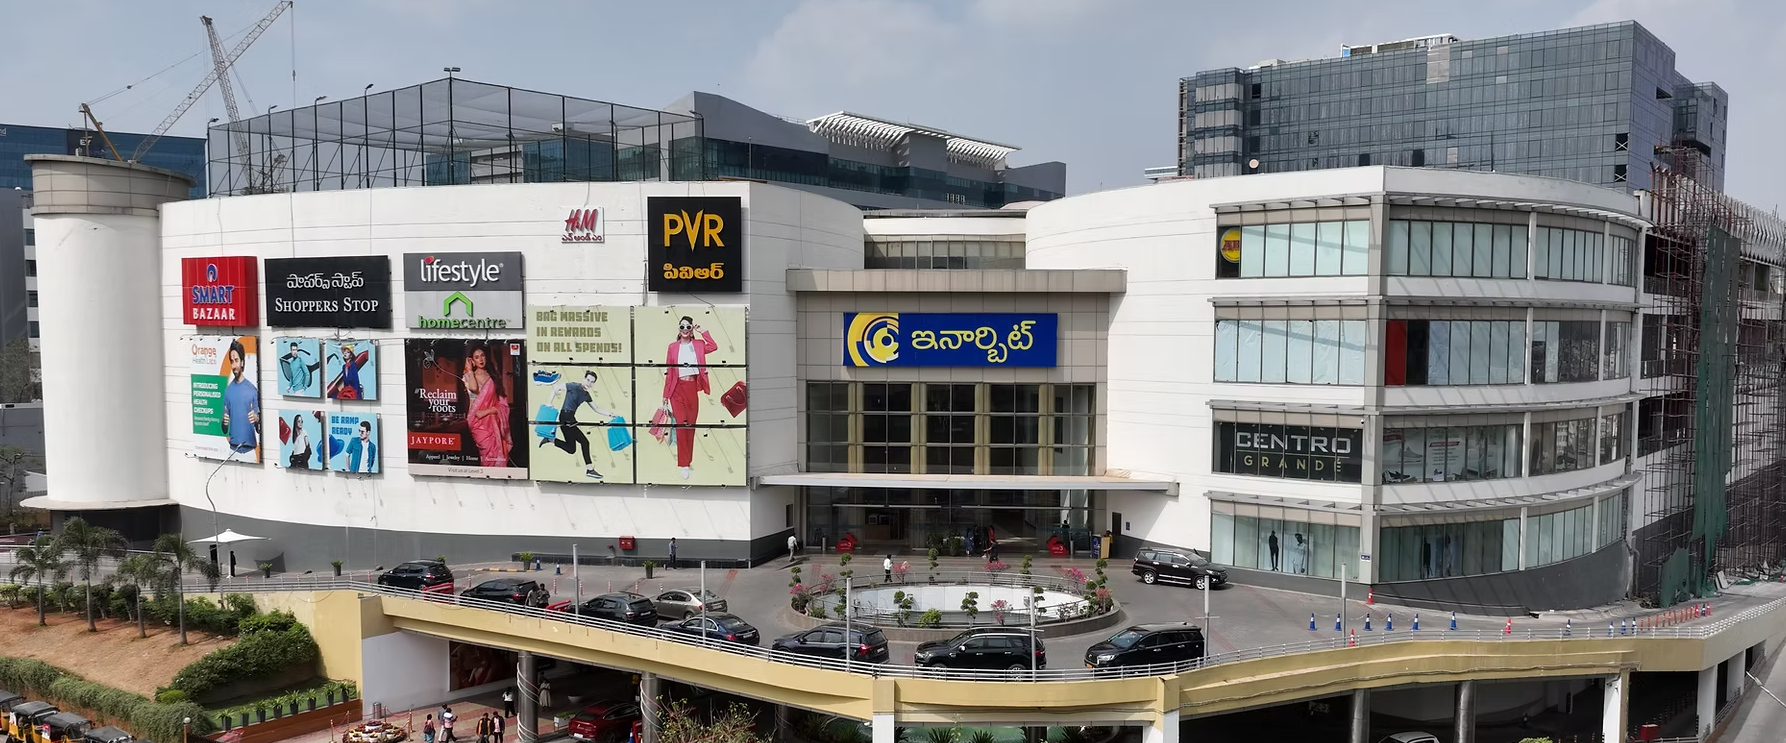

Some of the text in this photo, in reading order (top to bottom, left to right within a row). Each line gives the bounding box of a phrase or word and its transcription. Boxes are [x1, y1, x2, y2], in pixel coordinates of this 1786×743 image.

[565, 208, 598, 232] H&M
[663, 209, 725, 251] PVR
[663, 262, 725, 280] పివిఆర్
[331, 271, 364, 289] స్టాప్
[192, 285, 234, 304] SMART
[275, 297, 379, 312] SHOPPERS STOP
[192, 307, 236, 320] BAZAAR
[536, 311, 608, 322] BAG MASSIVE
[418, 315, 507, 329] homecentre
[536, 326, 602, 338] IN REWARDS
[536, 342, 622, 353] ON ALL SPENDS!
[911, 320, 1036, 363] ఇనార్బిట్
[191, 344, 217, 357] Orange
[428, 398, 451, 409] your
[432, 404, 456, 412] roots
[331, 416, 359, 424] BE RAMP
[331, 426, 352, 435] READY
[410, 436, 455, 445] JAYPORE
[1236, 432, 1351, 453] CENTRO
